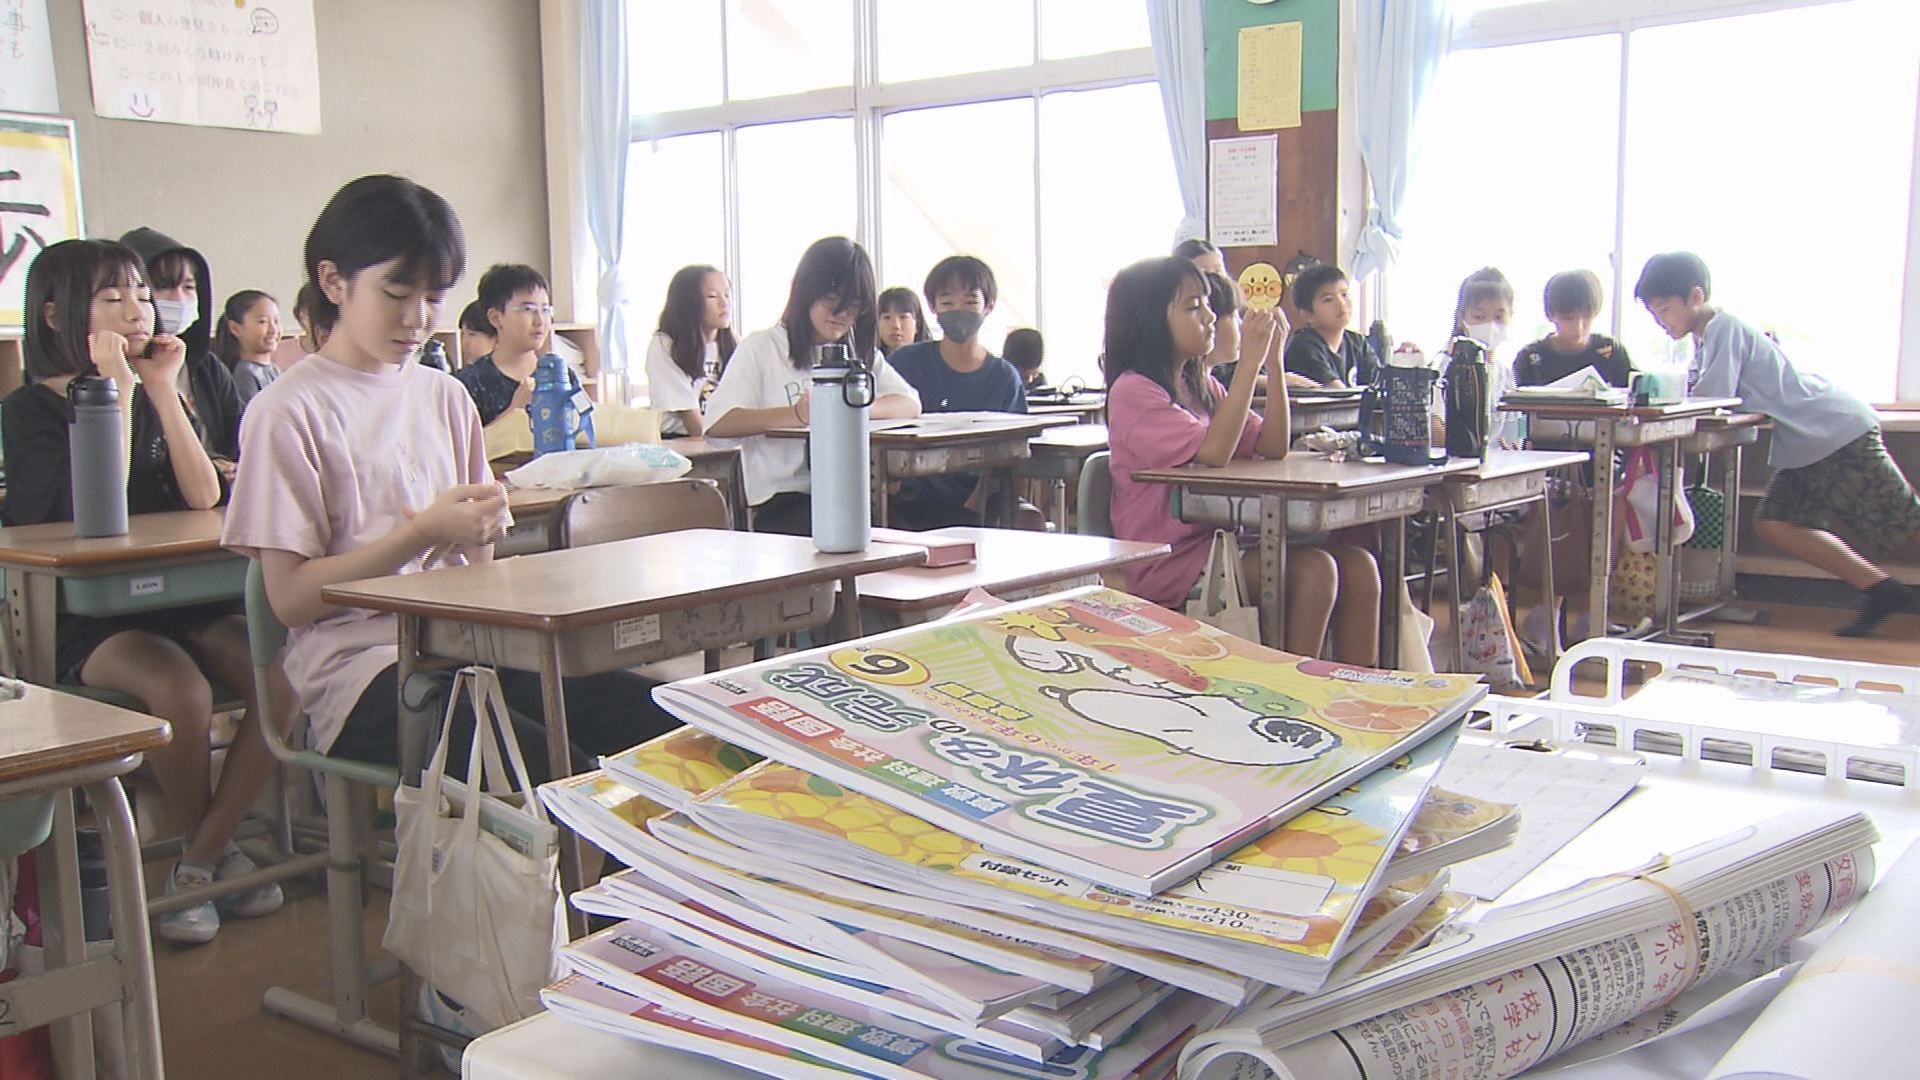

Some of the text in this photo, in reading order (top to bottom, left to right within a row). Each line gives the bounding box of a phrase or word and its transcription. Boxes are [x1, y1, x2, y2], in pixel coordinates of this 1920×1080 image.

[749, 700, 835, 738] 国語
[979, 859, 1069, 888] 付録セット
[657, 958, 748, 997] 国語
